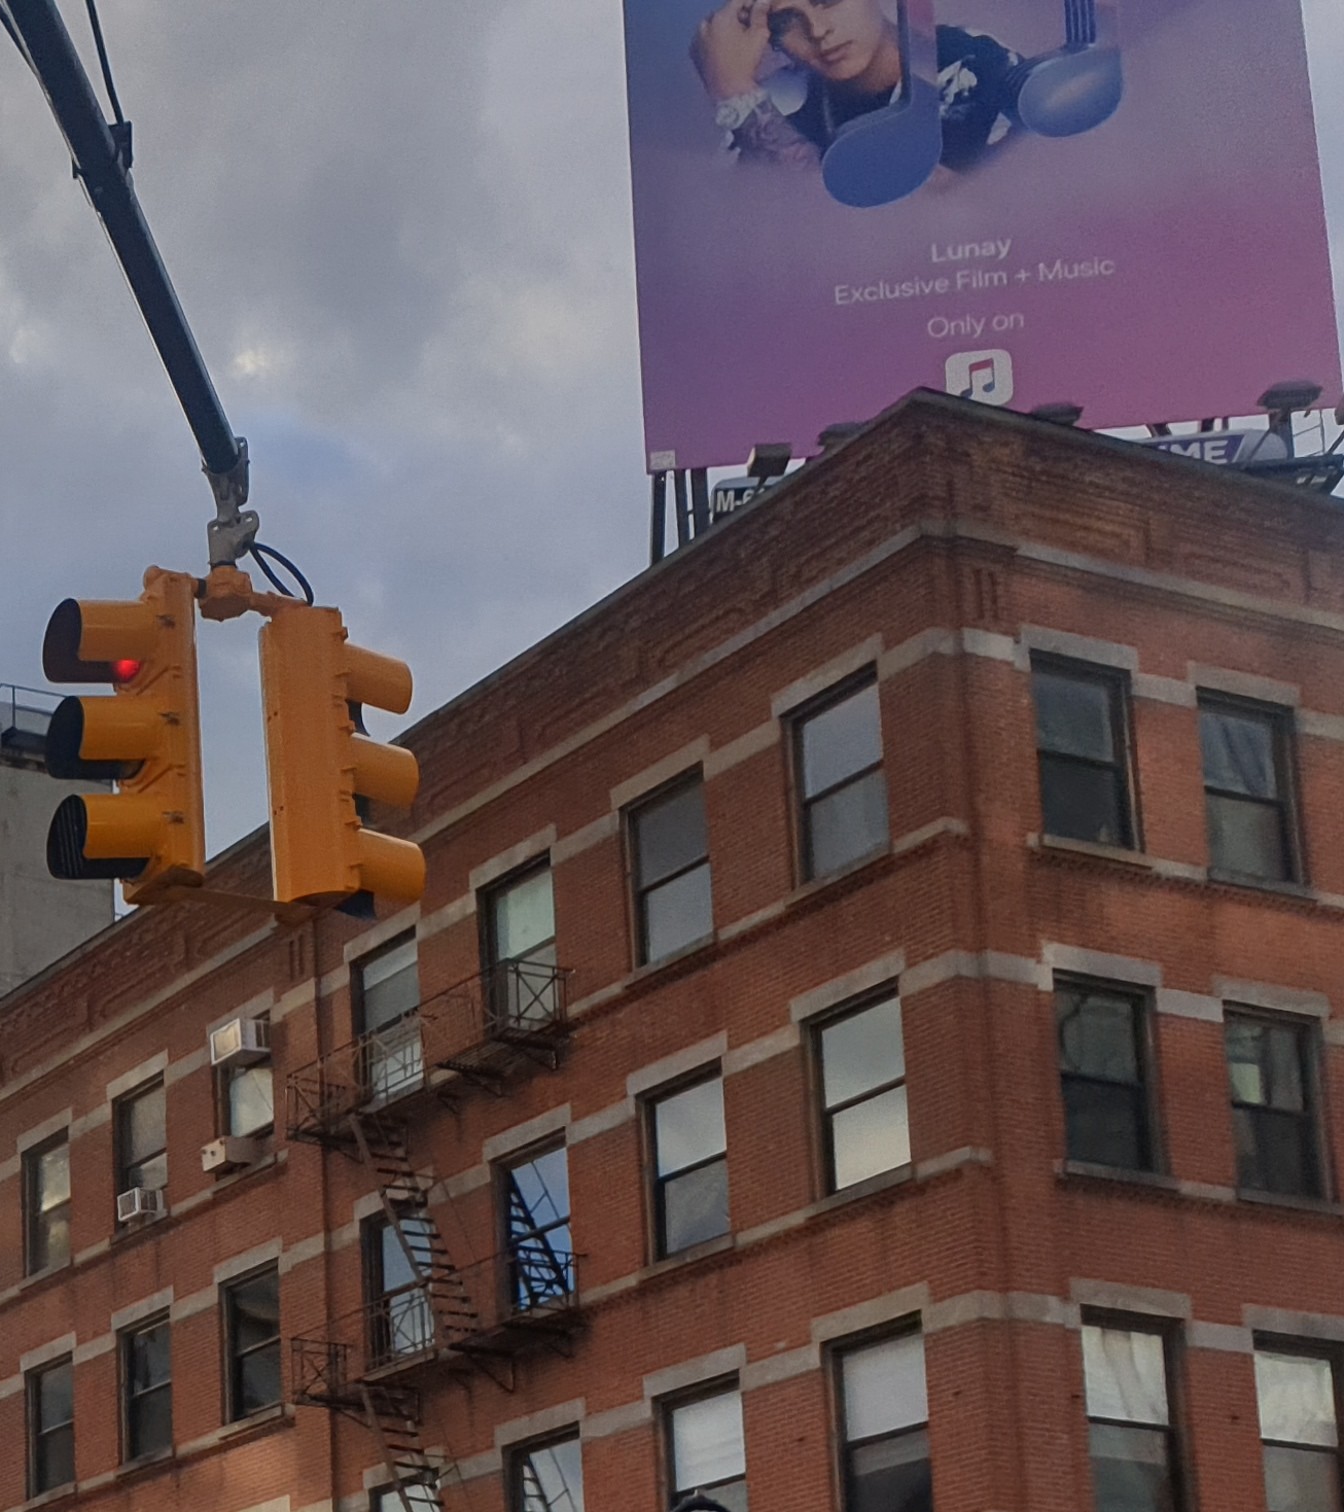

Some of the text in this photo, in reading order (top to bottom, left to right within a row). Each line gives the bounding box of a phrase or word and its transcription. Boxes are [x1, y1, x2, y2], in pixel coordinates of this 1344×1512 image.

[930, 238, 1012, 263] Lunay
[834, 276, 950, 305] Exclusive
[956, 268, 1008, 290] Film
[1038, 256, 1116, 282] Music
[926, 312, 1025, 338] Only on
